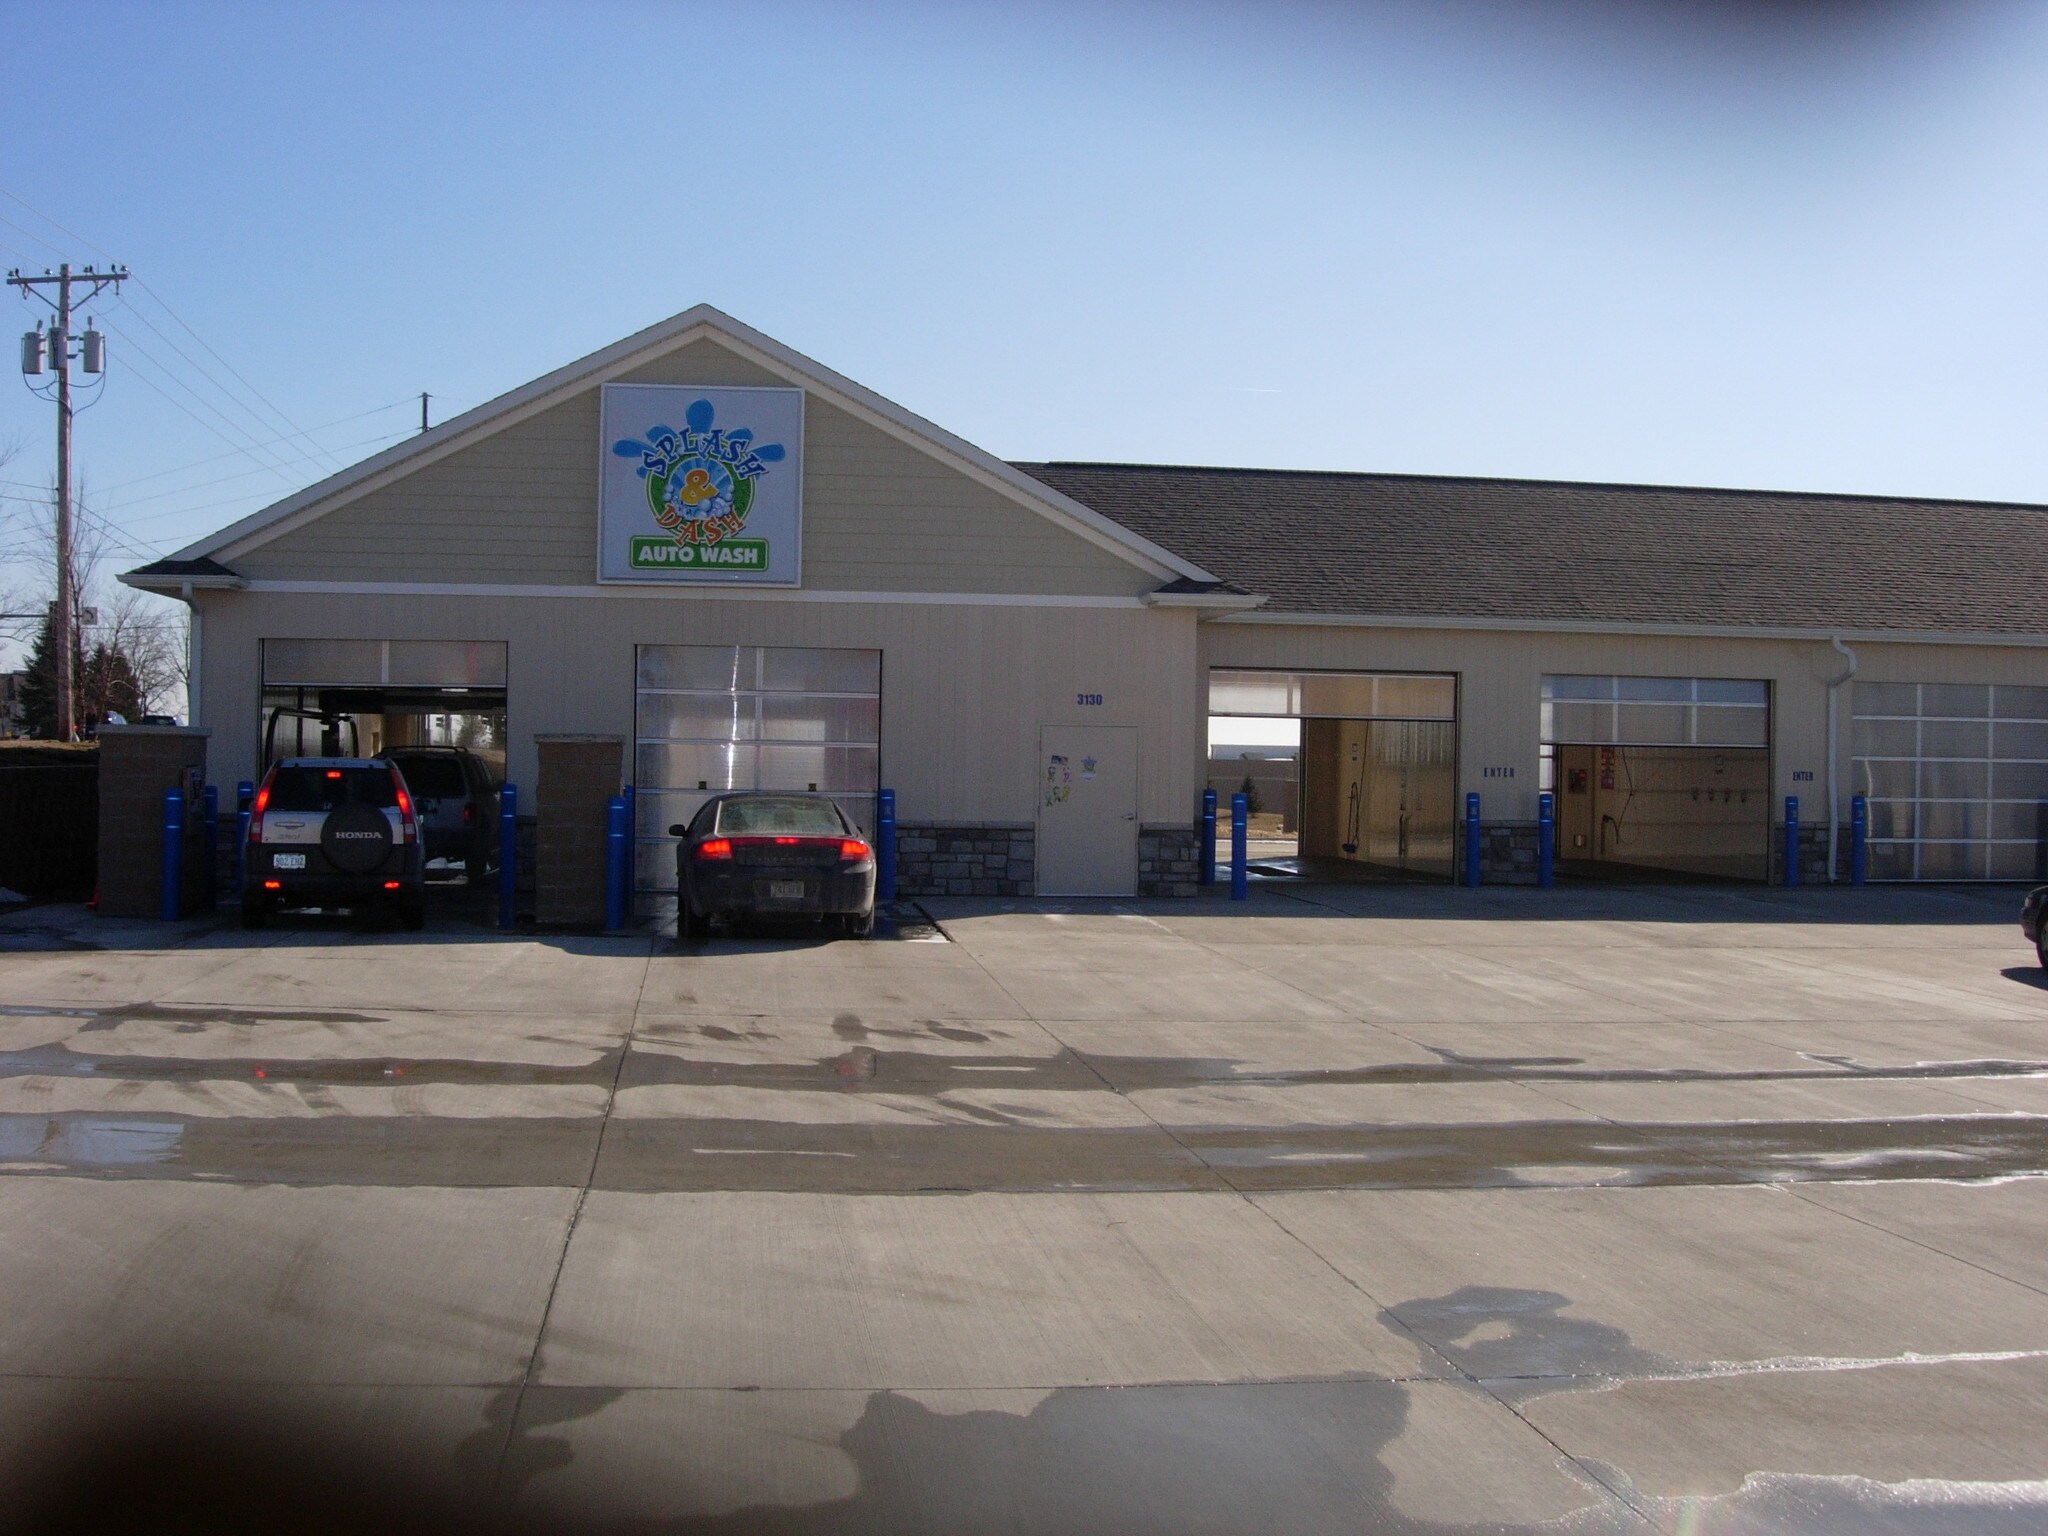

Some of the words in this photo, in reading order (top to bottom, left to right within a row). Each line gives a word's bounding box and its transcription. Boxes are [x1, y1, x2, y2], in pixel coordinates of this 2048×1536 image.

[643, 427, 768, 479] SPLASH
[680, 468, 719, 505] &
[656, 505, 746, 547] DASH
[639, 546, 694, 562] AUTO
[700, 548, 758, 564] WASH
[1077, 694, 1102, 705] 3130
[1484, 767, 1514, 777] ENTER
[1792, 771, 1814, 781] ENTER
